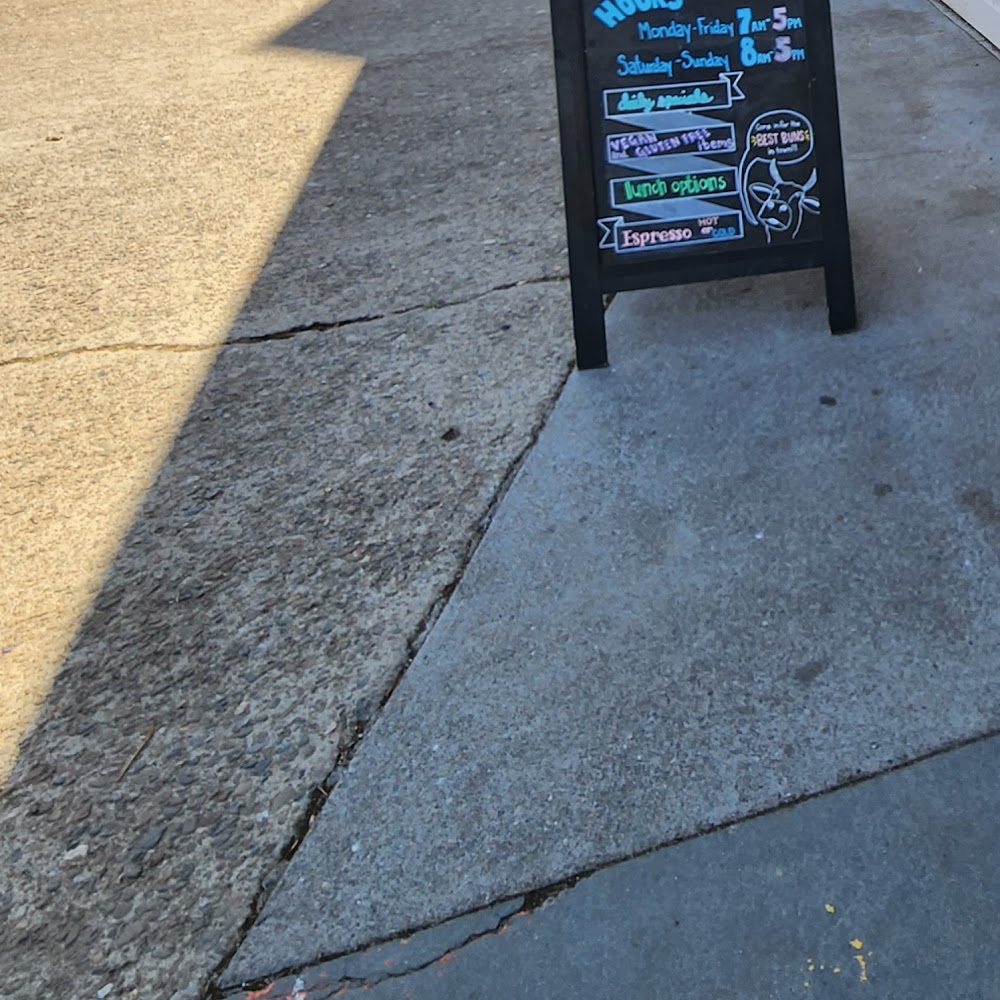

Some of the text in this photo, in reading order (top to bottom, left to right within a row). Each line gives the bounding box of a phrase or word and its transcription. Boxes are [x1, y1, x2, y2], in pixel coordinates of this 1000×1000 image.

[617, 91, 656, 114] daily
[610, 132, 658, 152] VEGAN
[634, 136, 681, 158] GLUTEN
[680, 128, 712, 146] FREE
[697, 137, 735, 152] items
[756, 130, 806, 147] BEST BUNS
[625, 174, 727, 201] lunch options
[698, 216, 720, 227] HOT
[621, 226, 693, 248] Espresso
[712, 226, 736, 238] COLD
